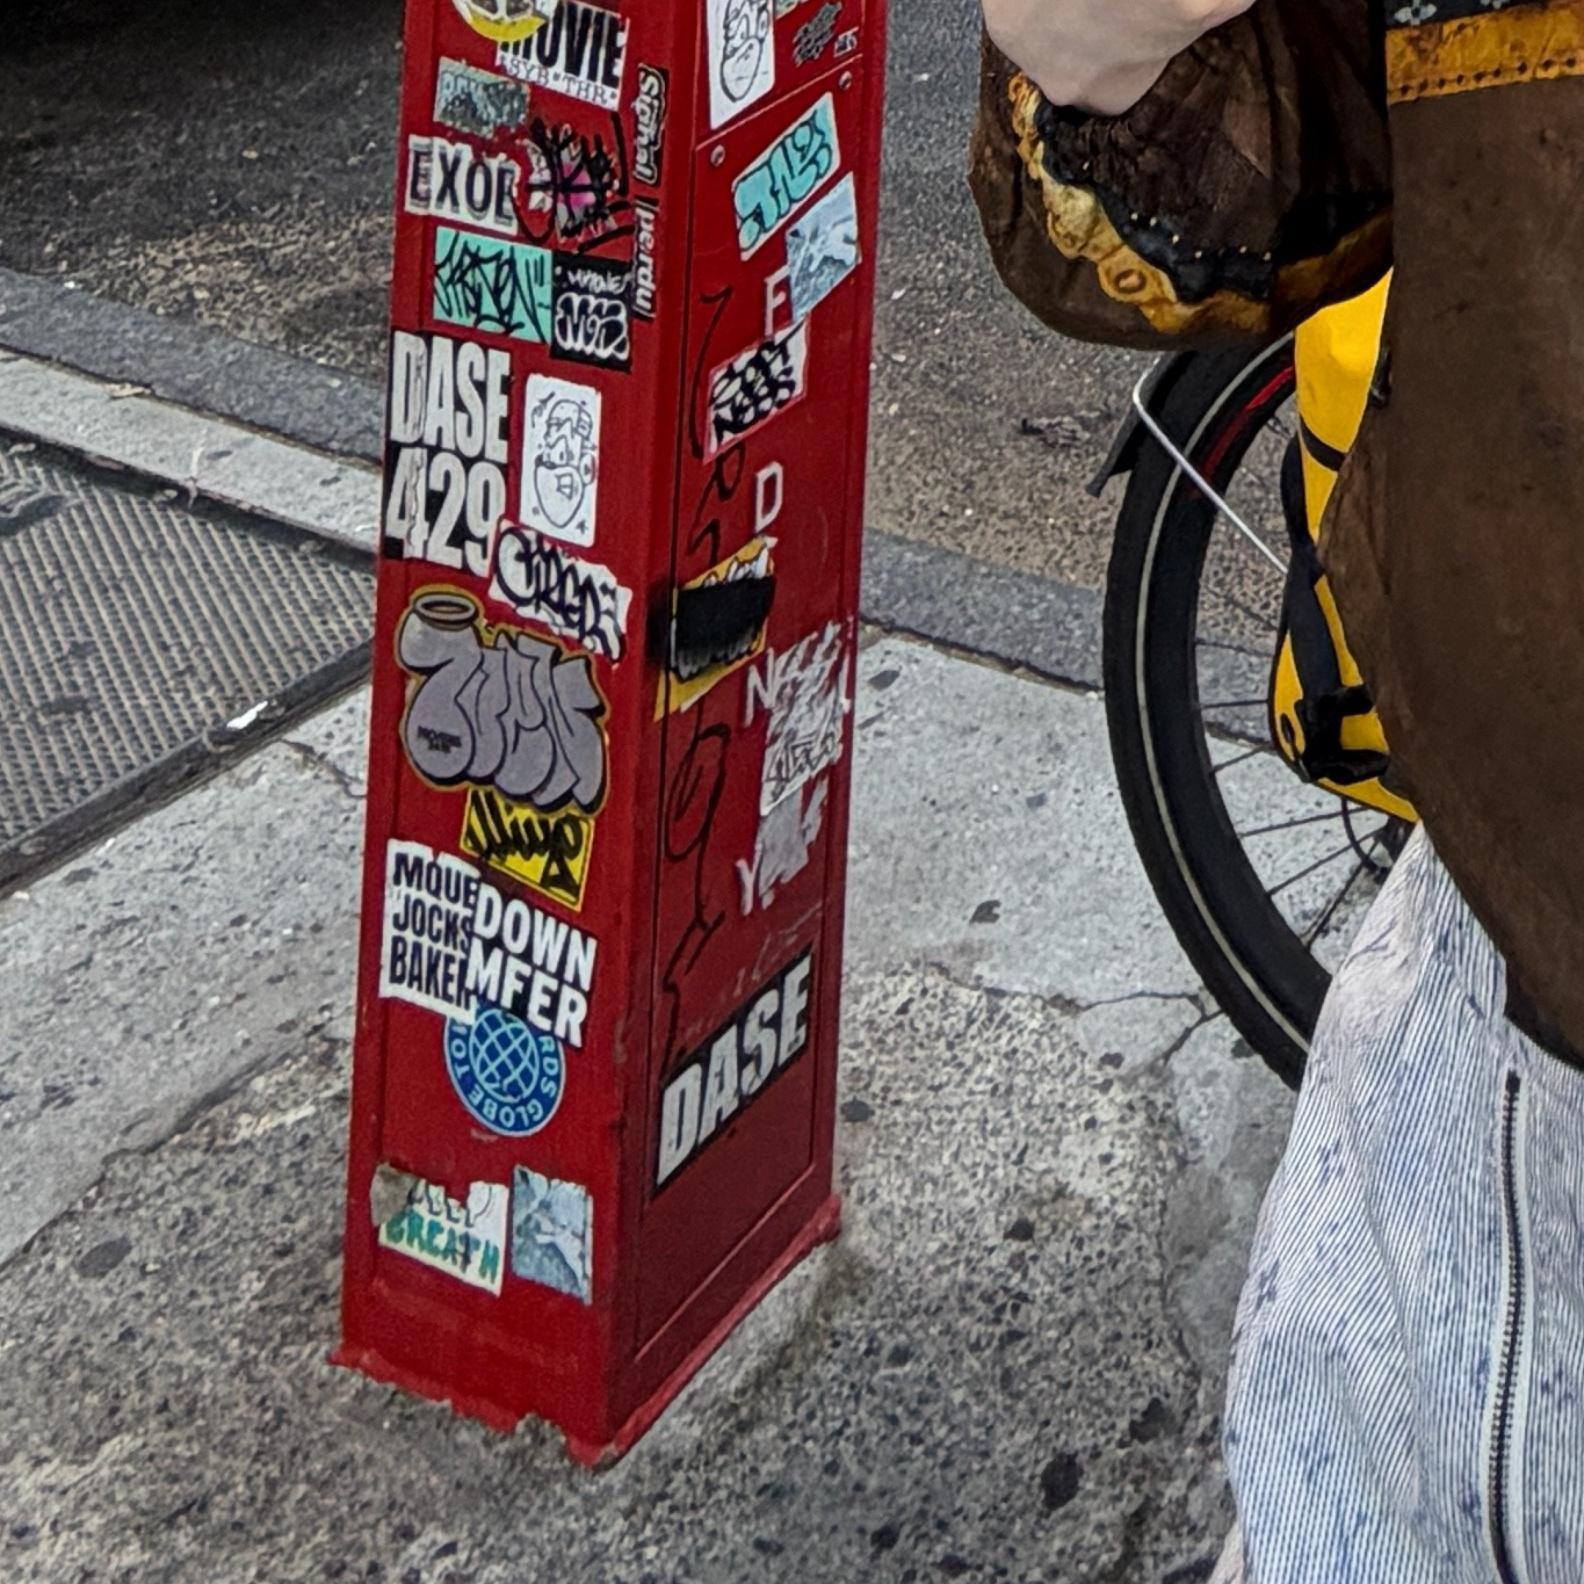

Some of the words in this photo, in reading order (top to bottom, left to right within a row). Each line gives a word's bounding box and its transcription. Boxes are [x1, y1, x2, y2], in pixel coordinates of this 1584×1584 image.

[635, 69, 661, 184] Signal
[635, 204, 655, 312] perdu
[390, 331, 513, 463] DASE
[386, 446, 506, 575] 429
[465, 936, 590, 1049] MFER
[475, 882, 598, 991] DOWN
[657, 951, 812, 1189] DASE
